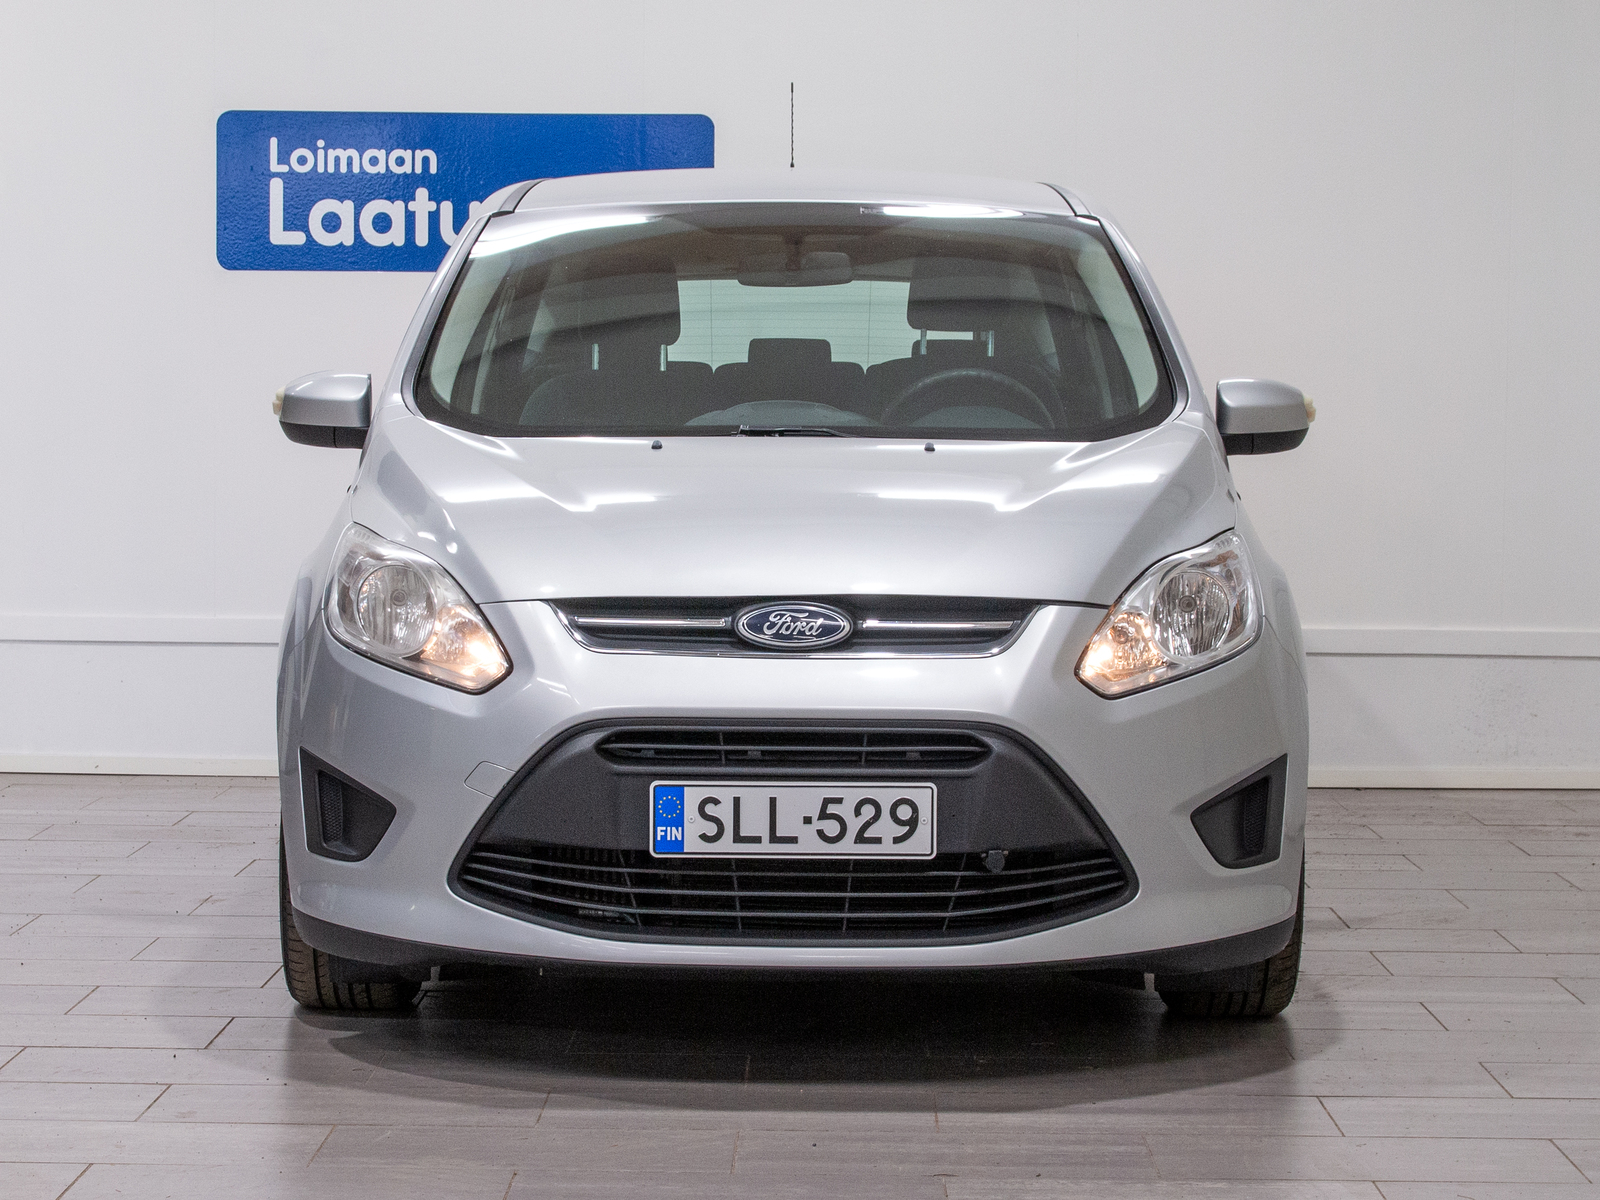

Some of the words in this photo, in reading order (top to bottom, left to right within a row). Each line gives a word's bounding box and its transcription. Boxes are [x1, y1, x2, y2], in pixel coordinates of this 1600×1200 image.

[269, 137, 437, 174] Loimaan
[763, 611, 824, 635] Ford
[656, 826, 683, 841] FIN
